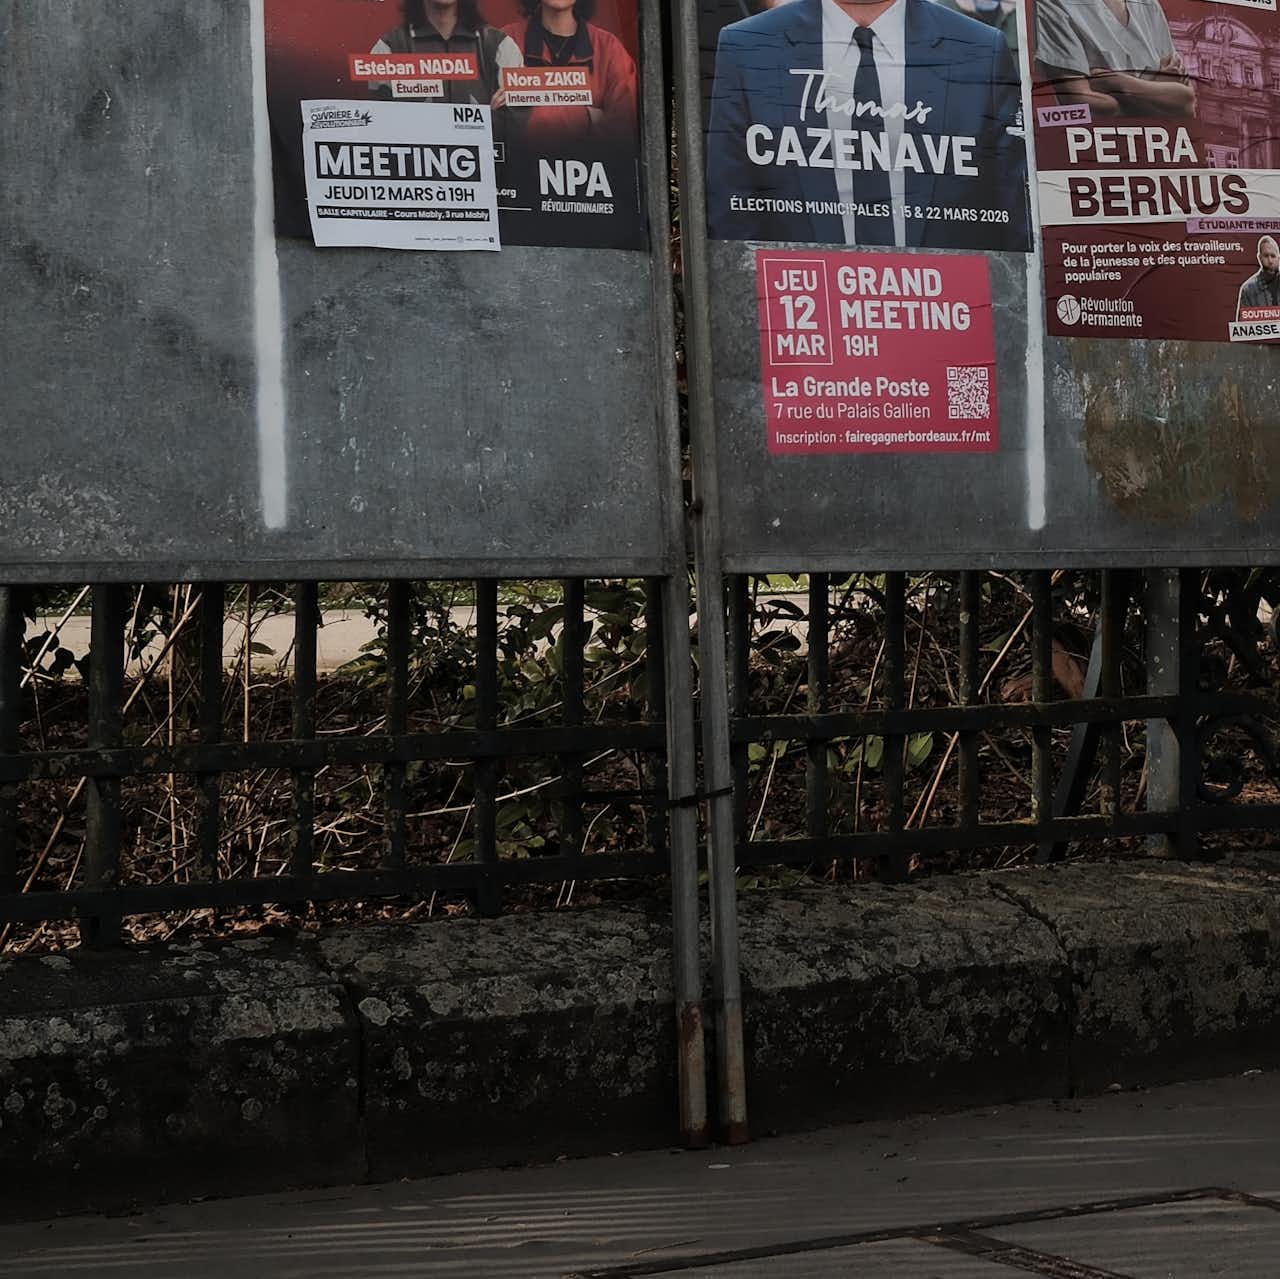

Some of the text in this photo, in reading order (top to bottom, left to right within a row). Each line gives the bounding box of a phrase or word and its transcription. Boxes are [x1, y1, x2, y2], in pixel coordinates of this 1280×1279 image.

[354, 58, 474, 76] Esteban NADAL
[396, 80, 439, 94] Étudiant
[506, 71, 588, 87] Nora ZAKRI
[789, 69, 933, 124] Thomas
[453, 107, 484, 123] NPA
[1042, 108, 1087, 123] VOTEZ
[745, 123, 979, 177] CAZENAVE
[1065, 126, 1198, 164] PETRA
[318, 145, 476, 179] MEETING
[538, 159, 613, 198] NPA
[324, 185, 475, 202] JEUDI 12 MARS à 19H
[1068, 174, 1250, 218] BERNUS
[1062, 240, 1244, 255] Pour porter la voix des travailleurs,
[1063, 253, 1225, 270] de la jeunesse et des quartiers
[774, 269, 818, 291] JEU
[837, 265, 943, 297] GRAND
[1065, 270, 1122, 284] populaires
[779, 295, 818, 330] 12
[1080, 297, 1134, 312] Révolution
[839, 299, 971, 330] MEETING
[1081, 312, 1143, 328] Permanente
[1232, 323, 1279, 337] ANASSE
[776, 334, 826, 356] MAR
[842, 334, 879, 357] 19H
[771, 376, 930, 397] La Grande Poste
[773, 402, 931, 419] 7 rue du Palais Gallien
